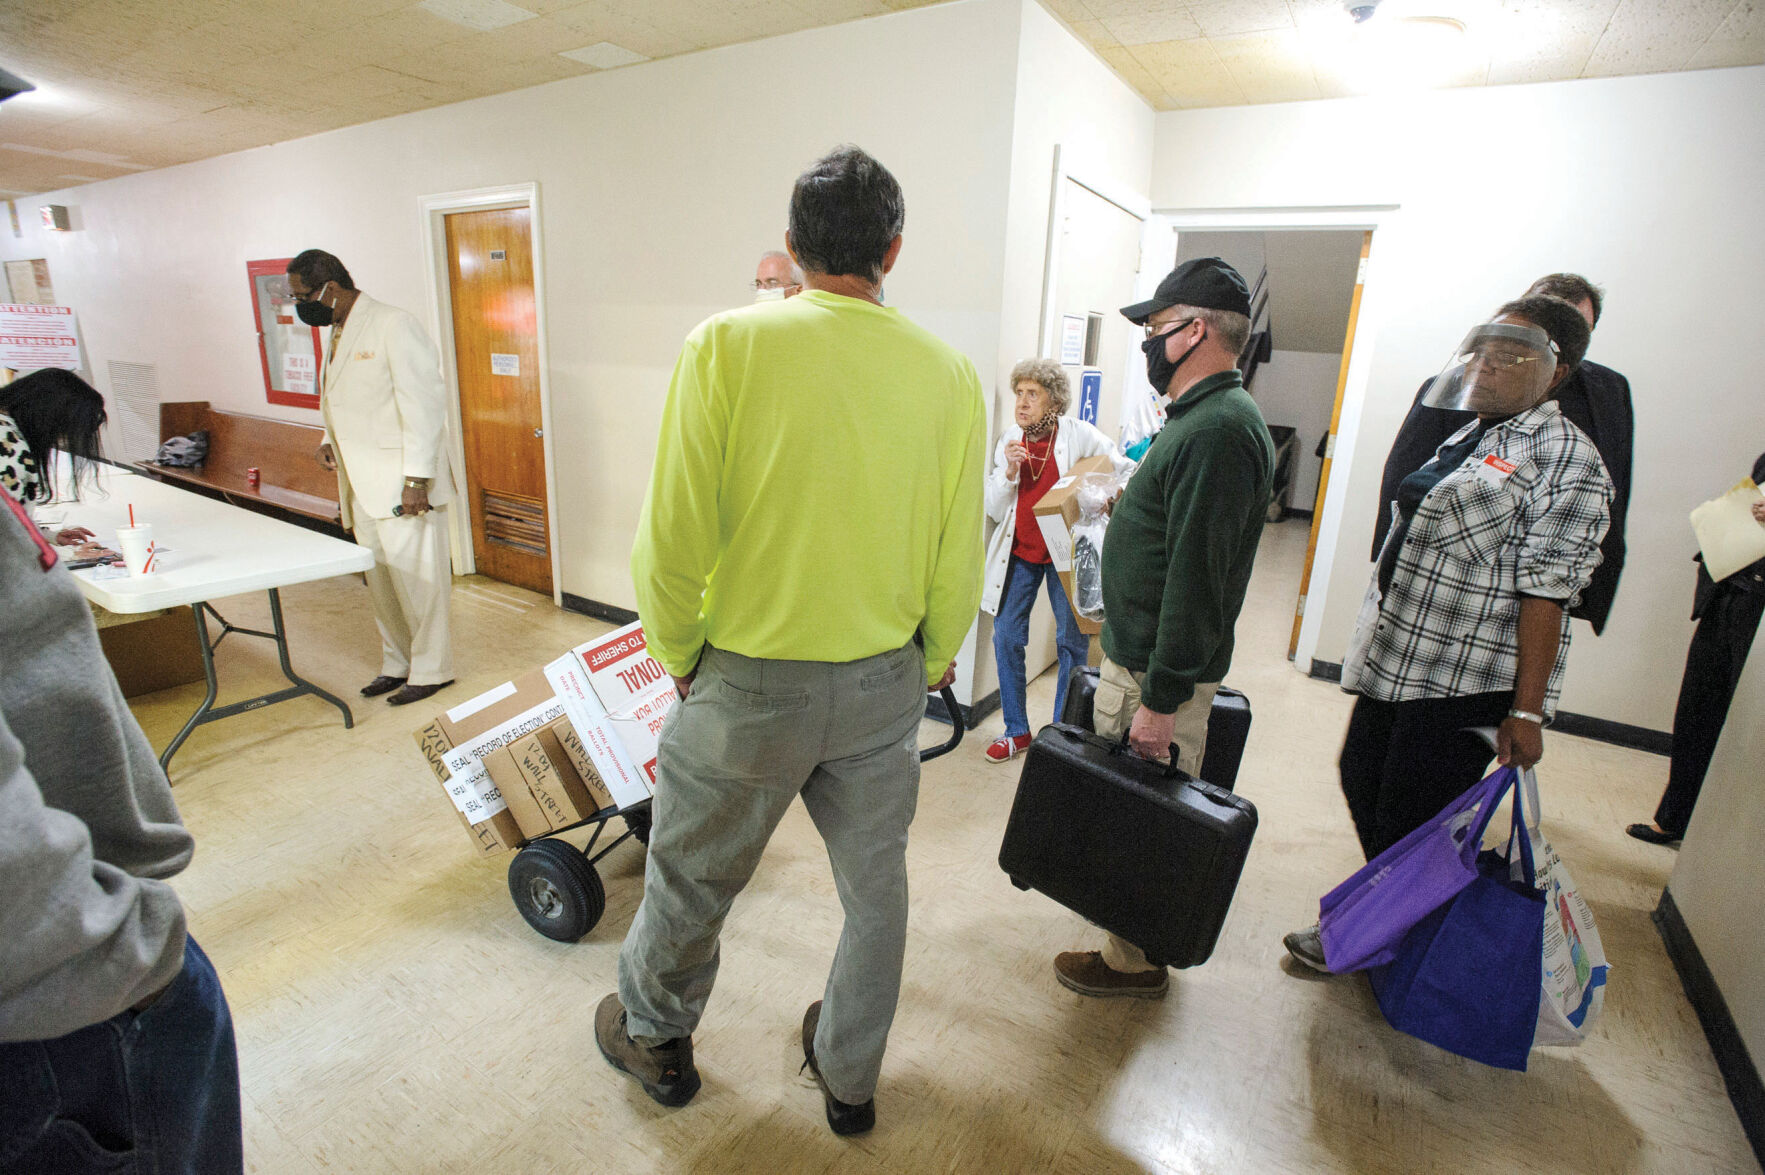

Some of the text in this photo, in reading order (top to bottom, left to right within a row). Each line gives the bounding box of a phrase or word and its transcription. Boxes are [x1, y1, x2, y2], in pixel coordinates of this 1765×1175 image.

[591, 641, 629, 667] SHERIFF
[628, 635, 643, 648] TO
[560, 675, 570, 692] DATE
[568, 671, 585, 700] PRECINCT
[451, 757, 471, 772] SEAL
[502, 731, 513, 744] OF
[587, 730, 604, 756] BALLOTS
[596, 726, 630, 785] TOTAL PROVISIONAL
[465, 800, 482, 813] SEAL
